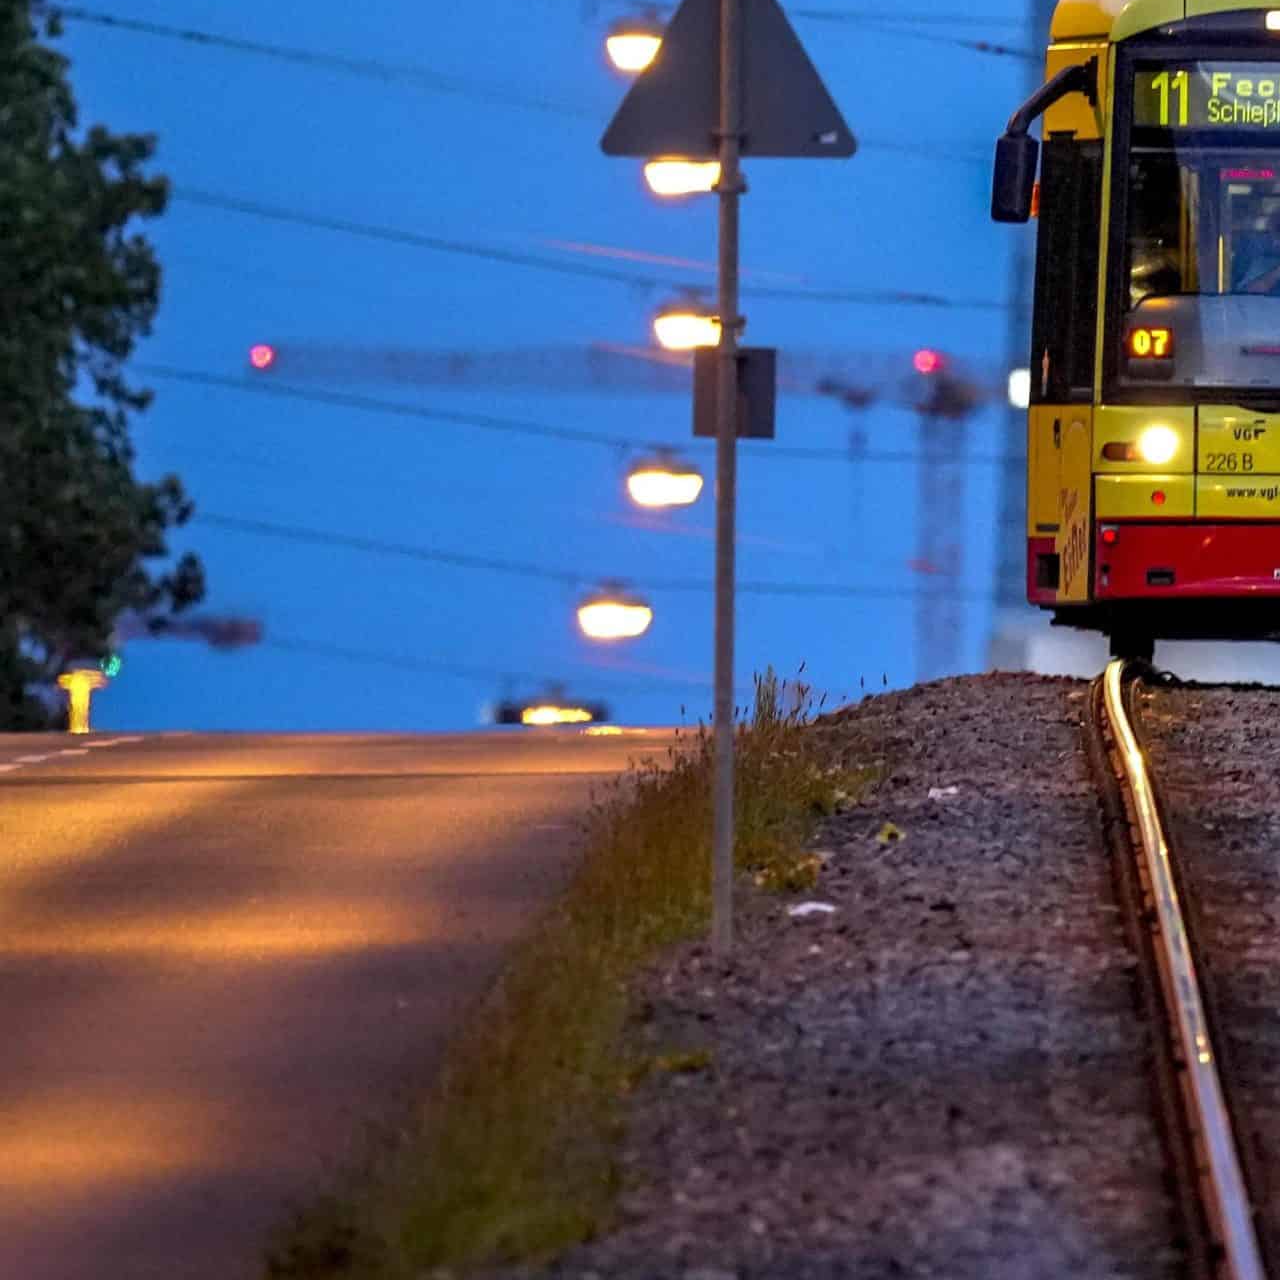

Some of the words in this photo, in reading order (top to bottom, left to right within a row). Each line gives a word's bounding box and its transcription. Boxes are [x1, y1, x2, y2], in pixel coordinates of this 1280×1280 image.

[1151, 70, 1189, 126] 11
[1132, 328, 1170, 357] 07
[1233, 420, 1266, 441] VGF
[1206, 453, 1238, 471] 226
[1242, 453, 1253, 471] B
